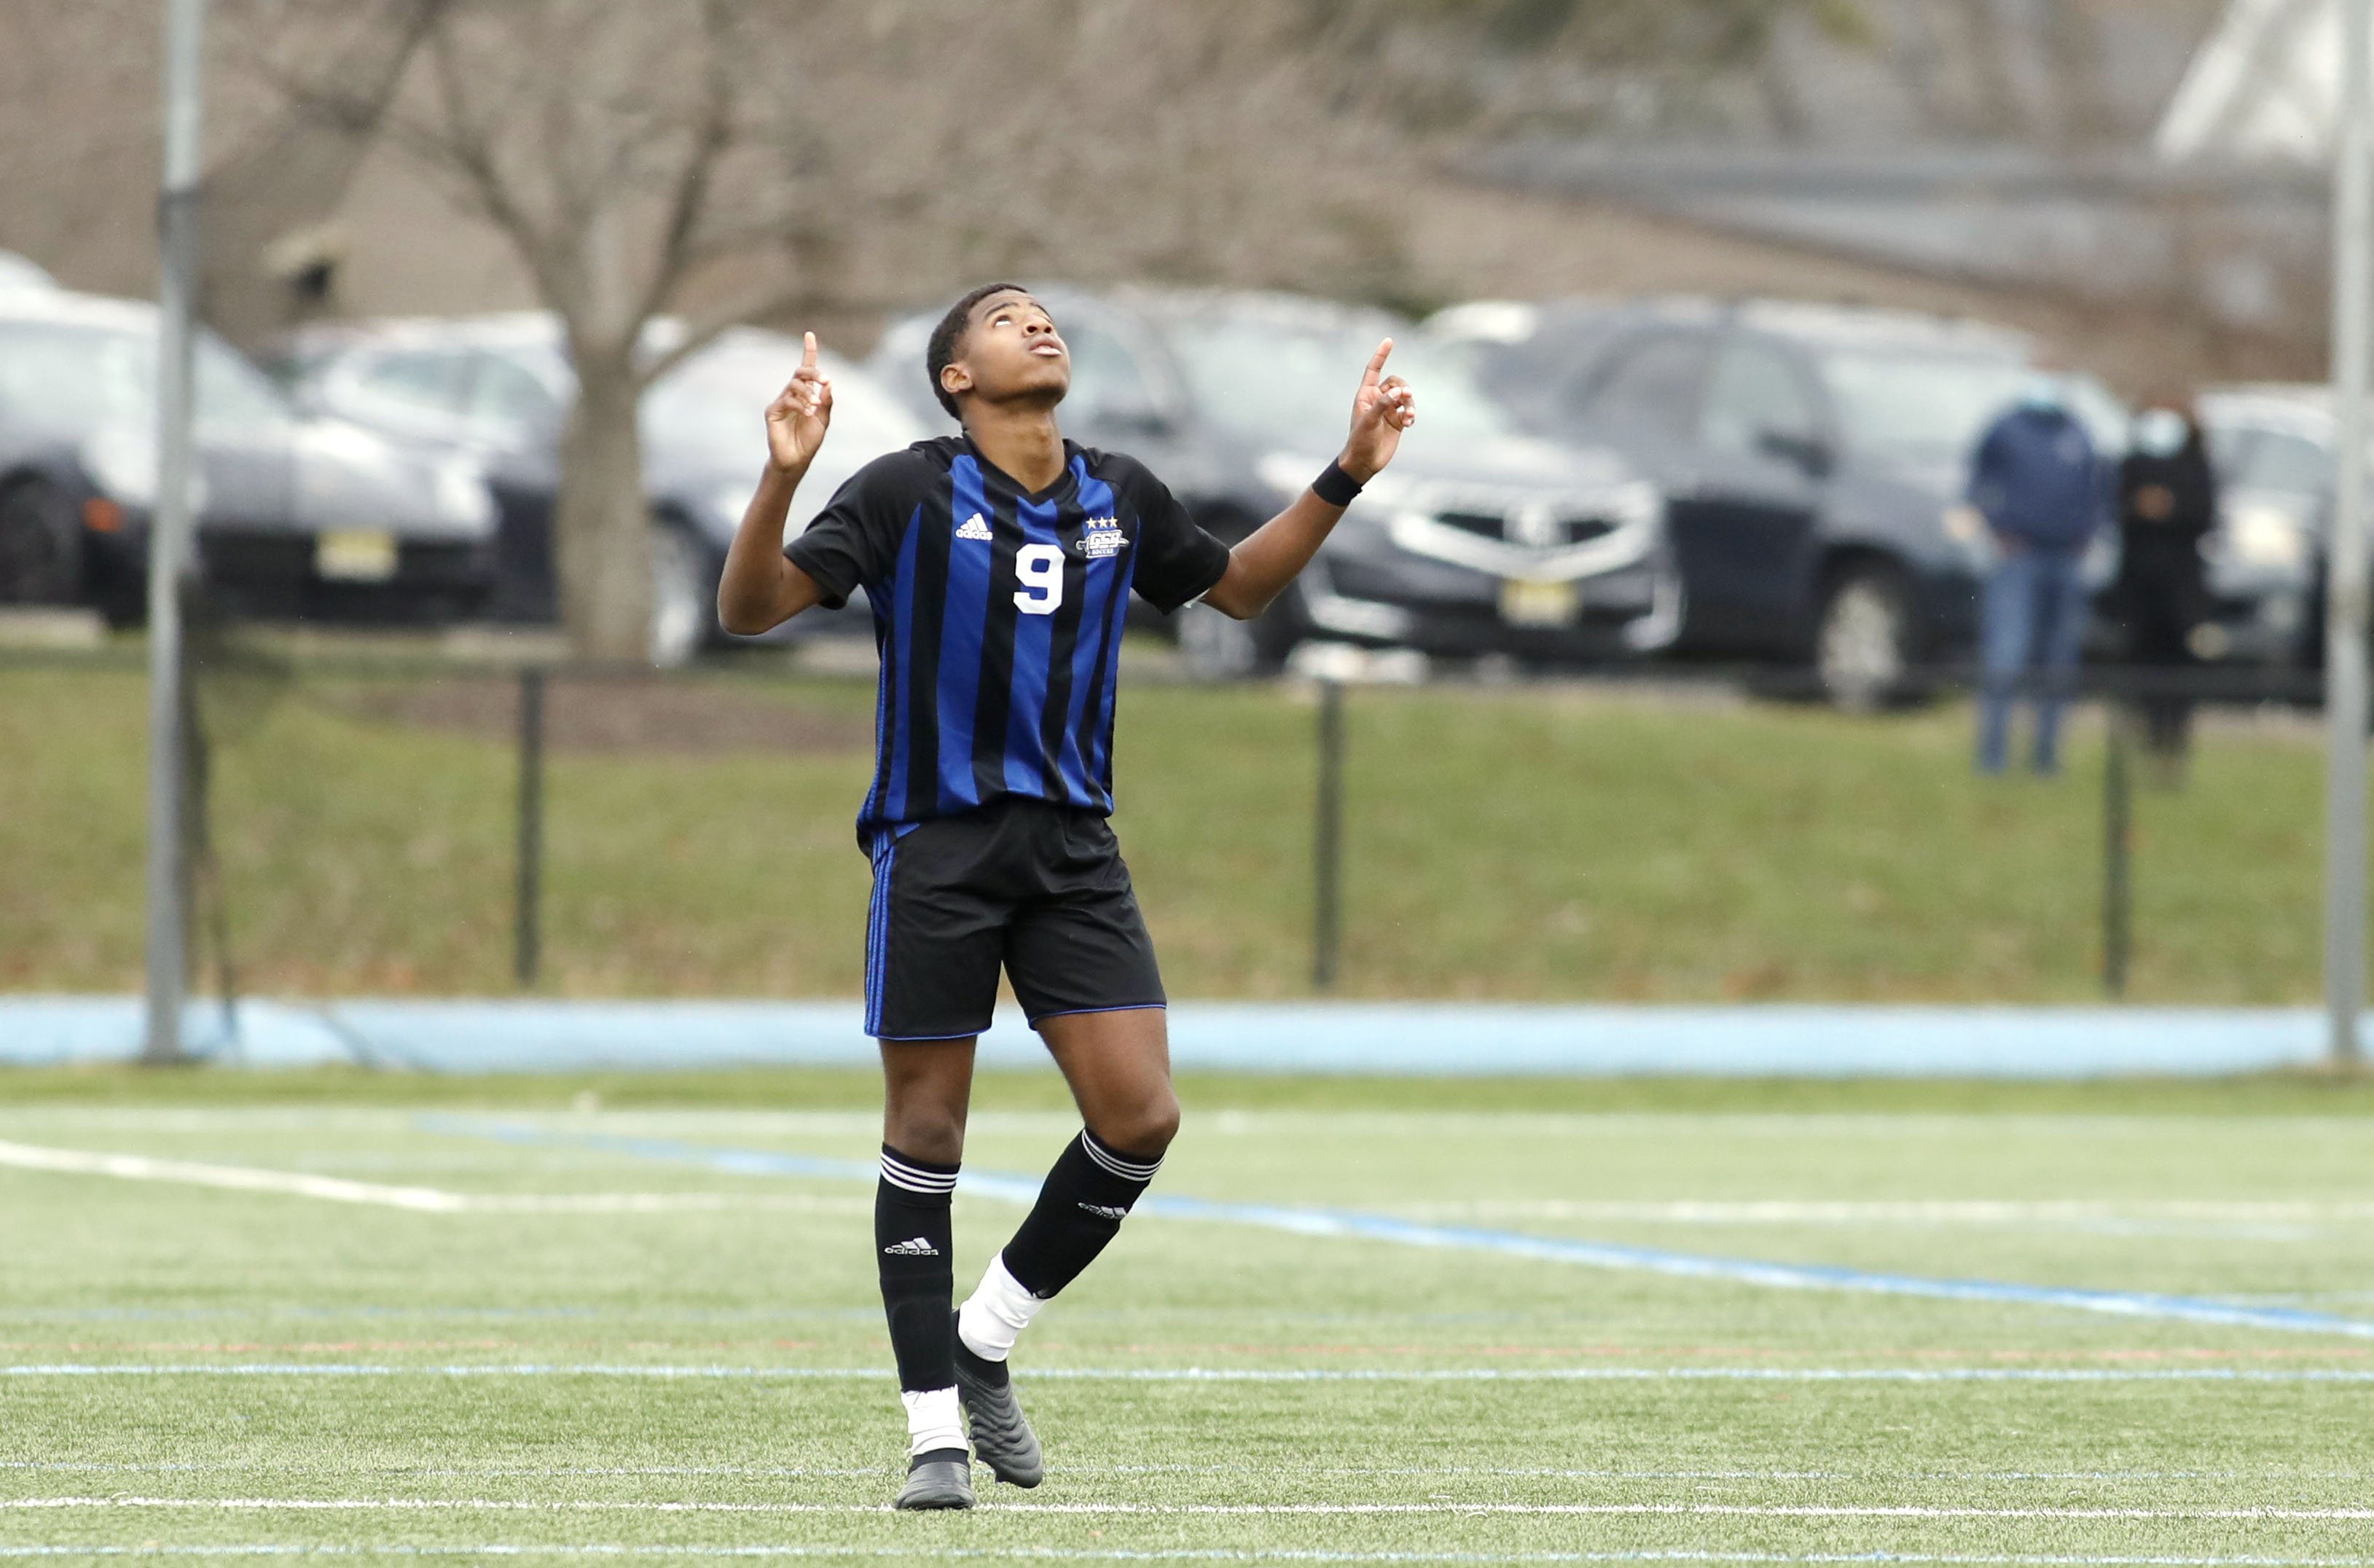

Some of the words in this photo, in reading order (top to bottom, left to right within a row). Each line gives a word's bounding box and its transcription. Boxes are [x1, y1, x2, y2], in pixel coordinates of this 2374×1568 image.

[955, 529, 993, 541] adidas
[1089, 532, 1121, 549] GSB
[1013, 544, 1065, 615] 9
[1078, 1202, 1125, 1219] adida
[884, 1247, 939, 1255] adidas
